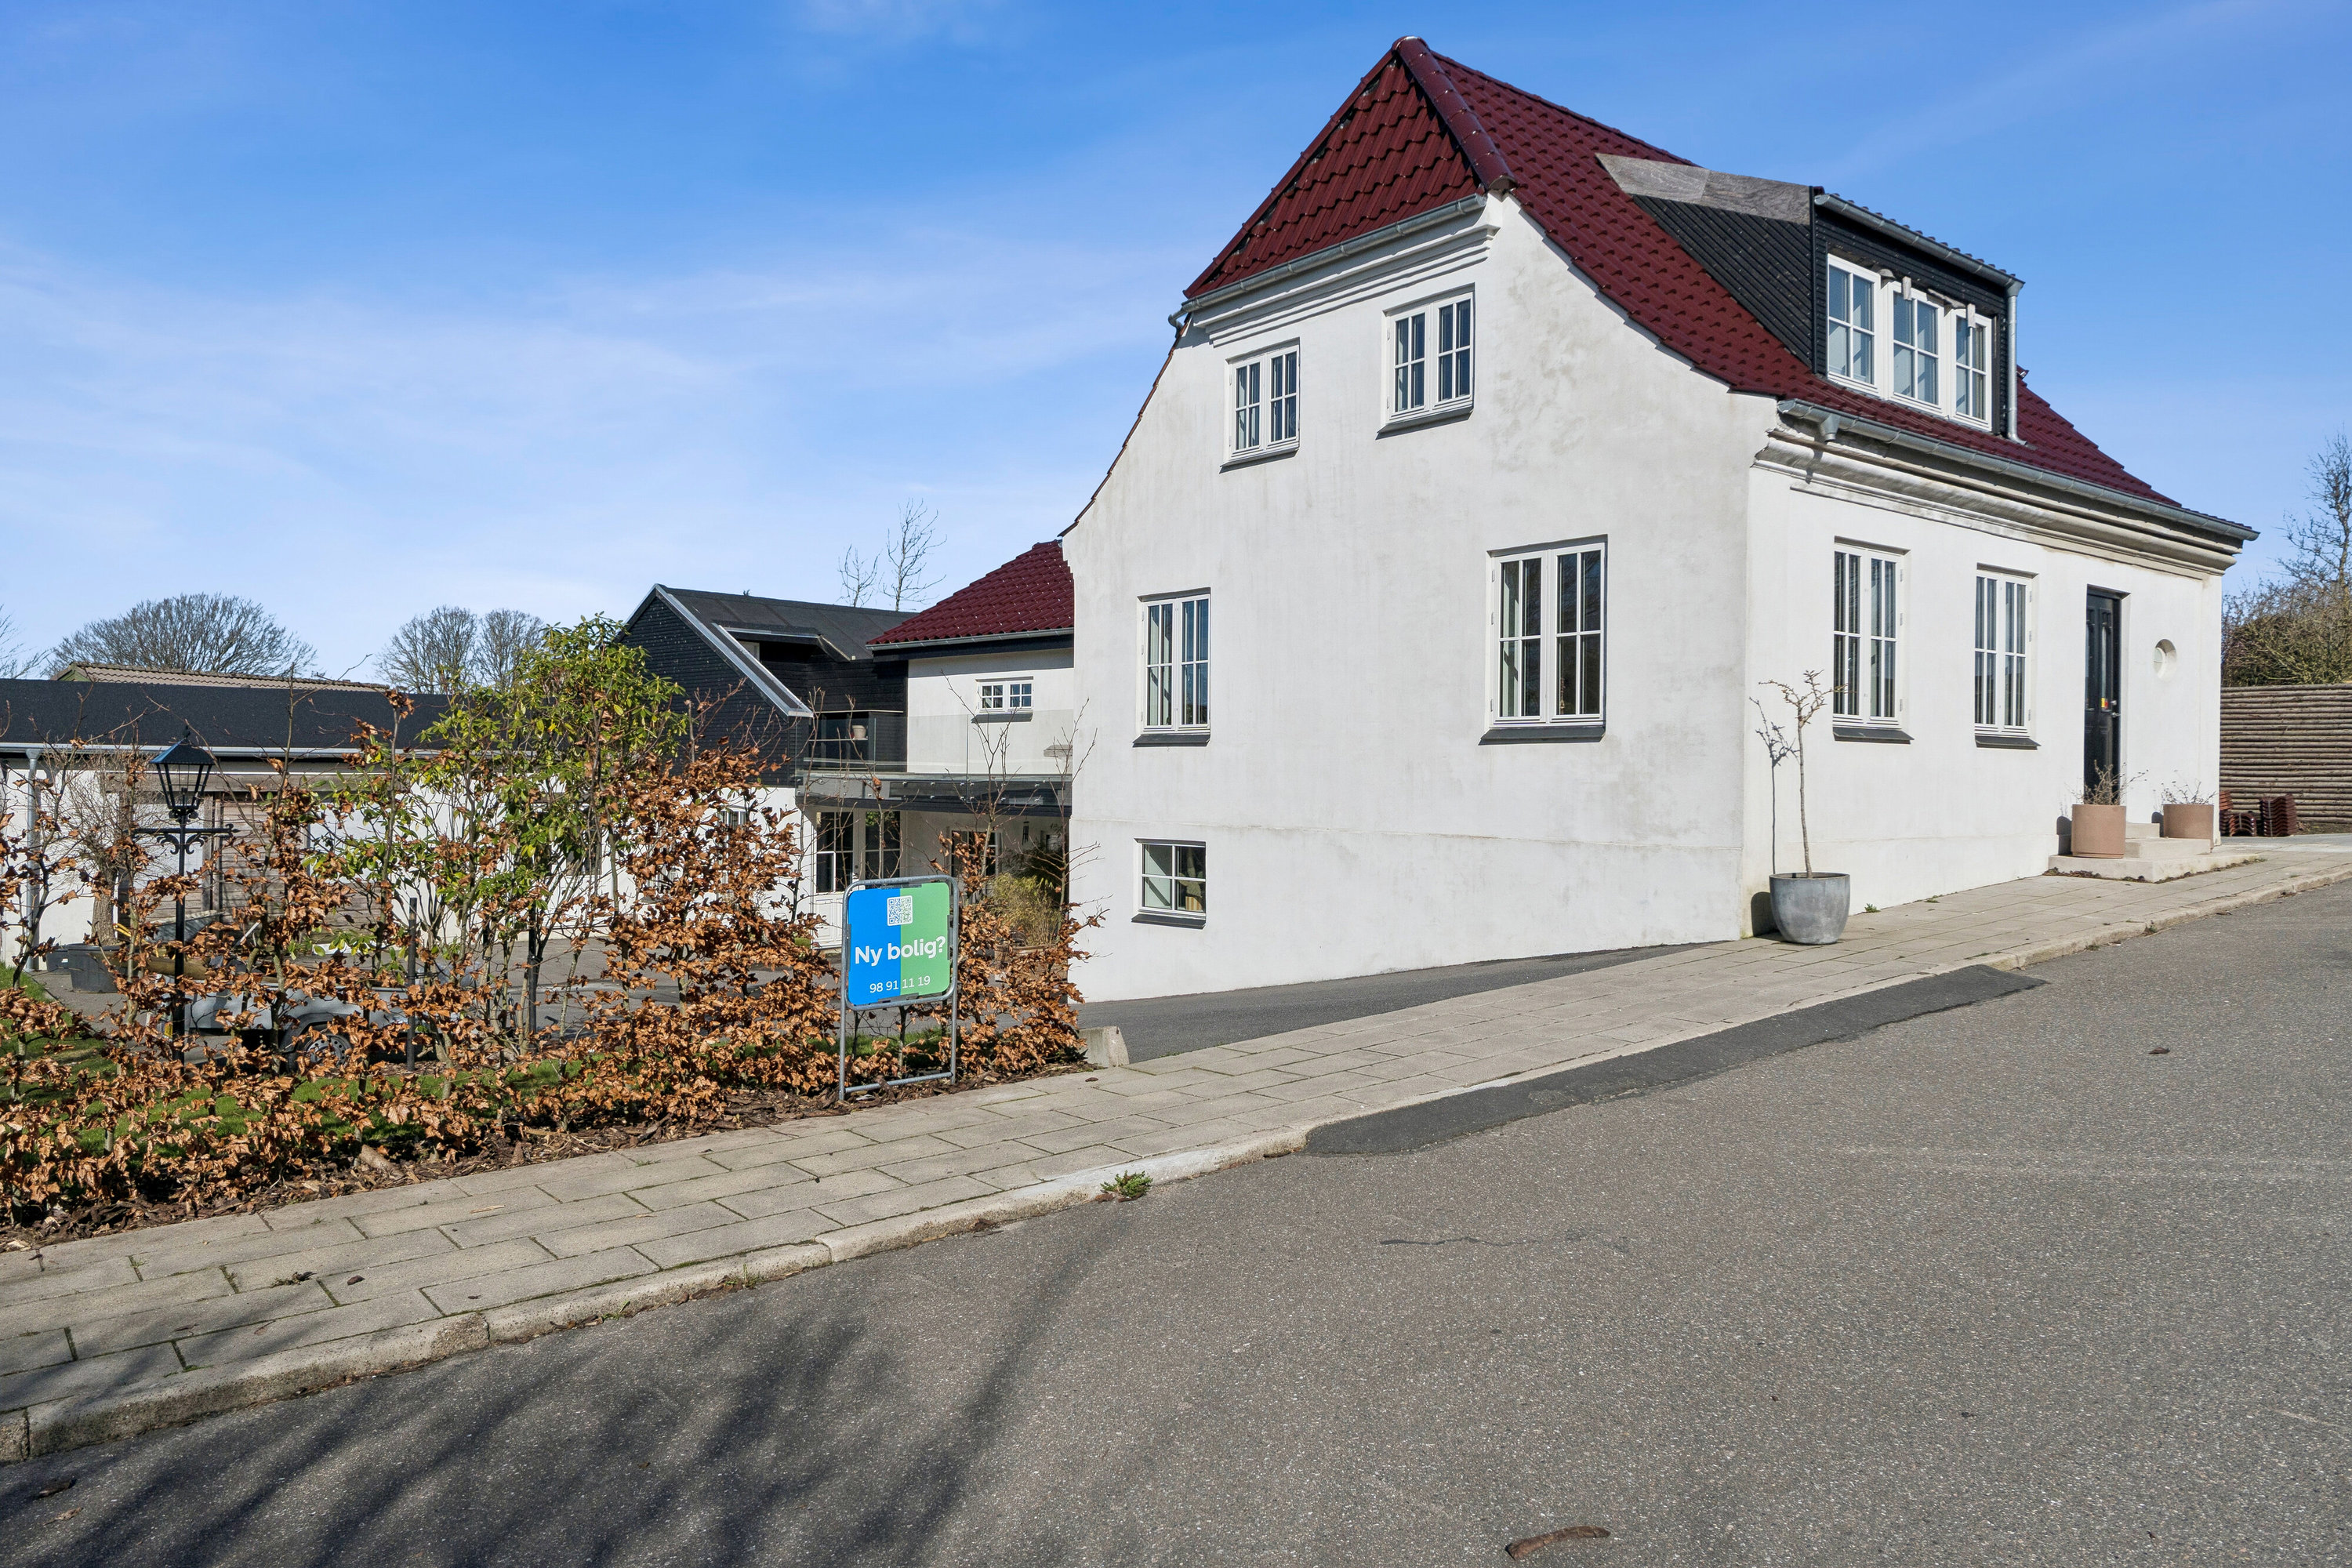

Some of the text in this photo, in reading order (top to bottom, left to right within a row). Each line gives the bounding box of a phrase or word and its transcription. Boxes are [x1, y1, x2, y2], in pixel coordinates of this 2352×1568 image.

[855, 935, 946, 967] Ny bolig?
[869, 975, 931, 993] 98 91 11 19
